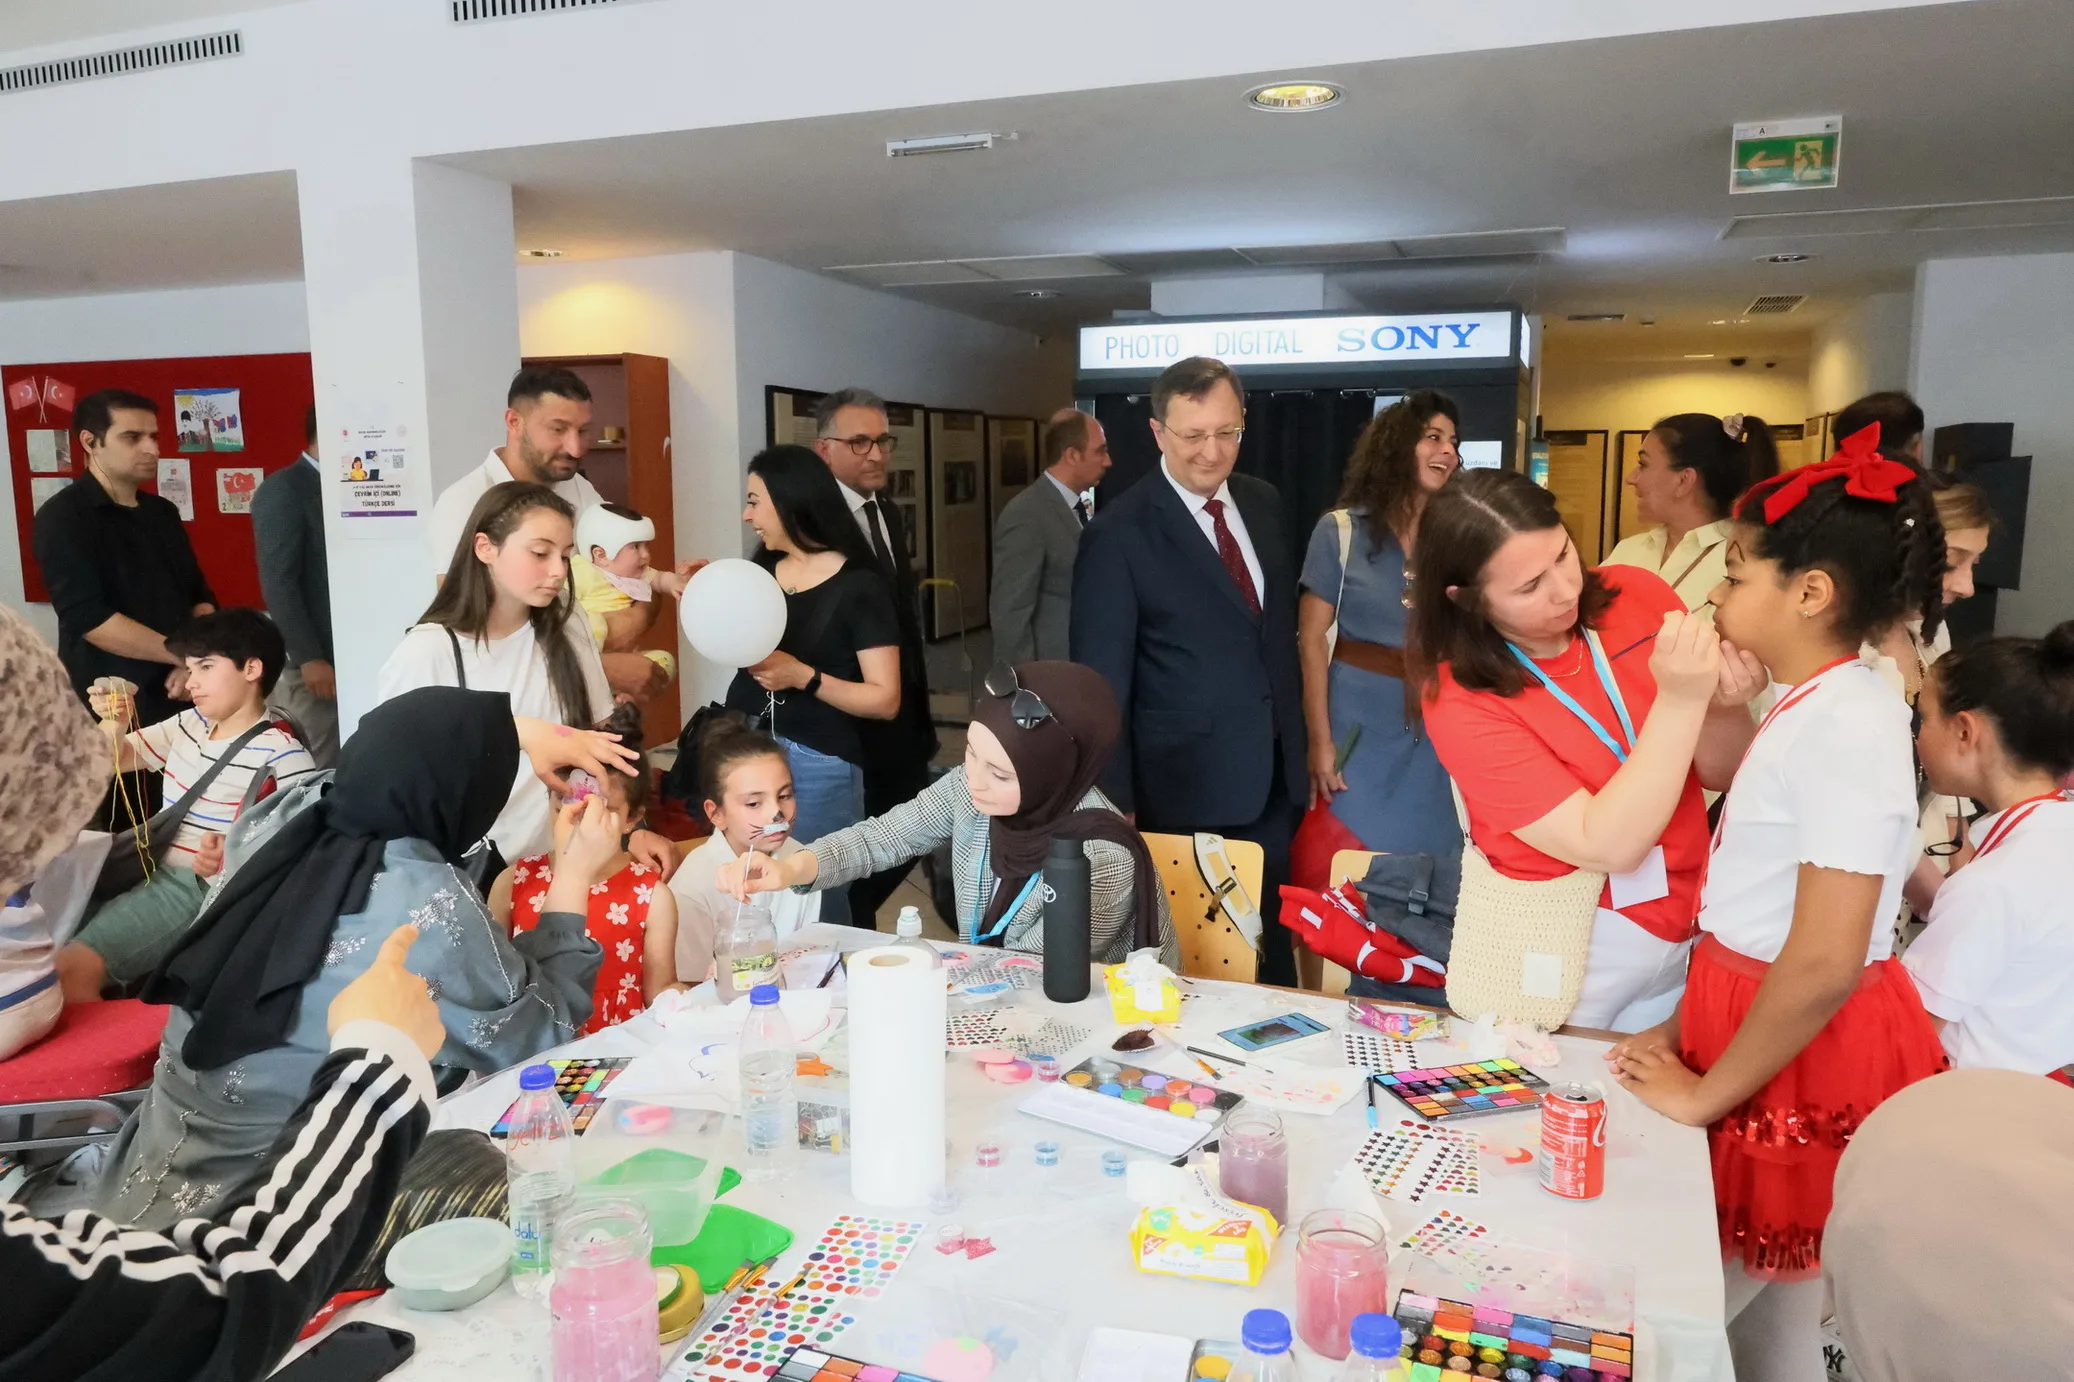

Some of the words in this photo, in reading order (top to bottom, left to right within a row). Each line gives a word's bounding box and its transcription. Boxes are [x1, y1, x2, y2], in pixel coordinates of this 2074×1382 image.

[1105, 333, 1180, 360] PHOTO
[1215, 329, 1303, 356] DIGITAL
[1337, 323, 1481, 352] SONY
